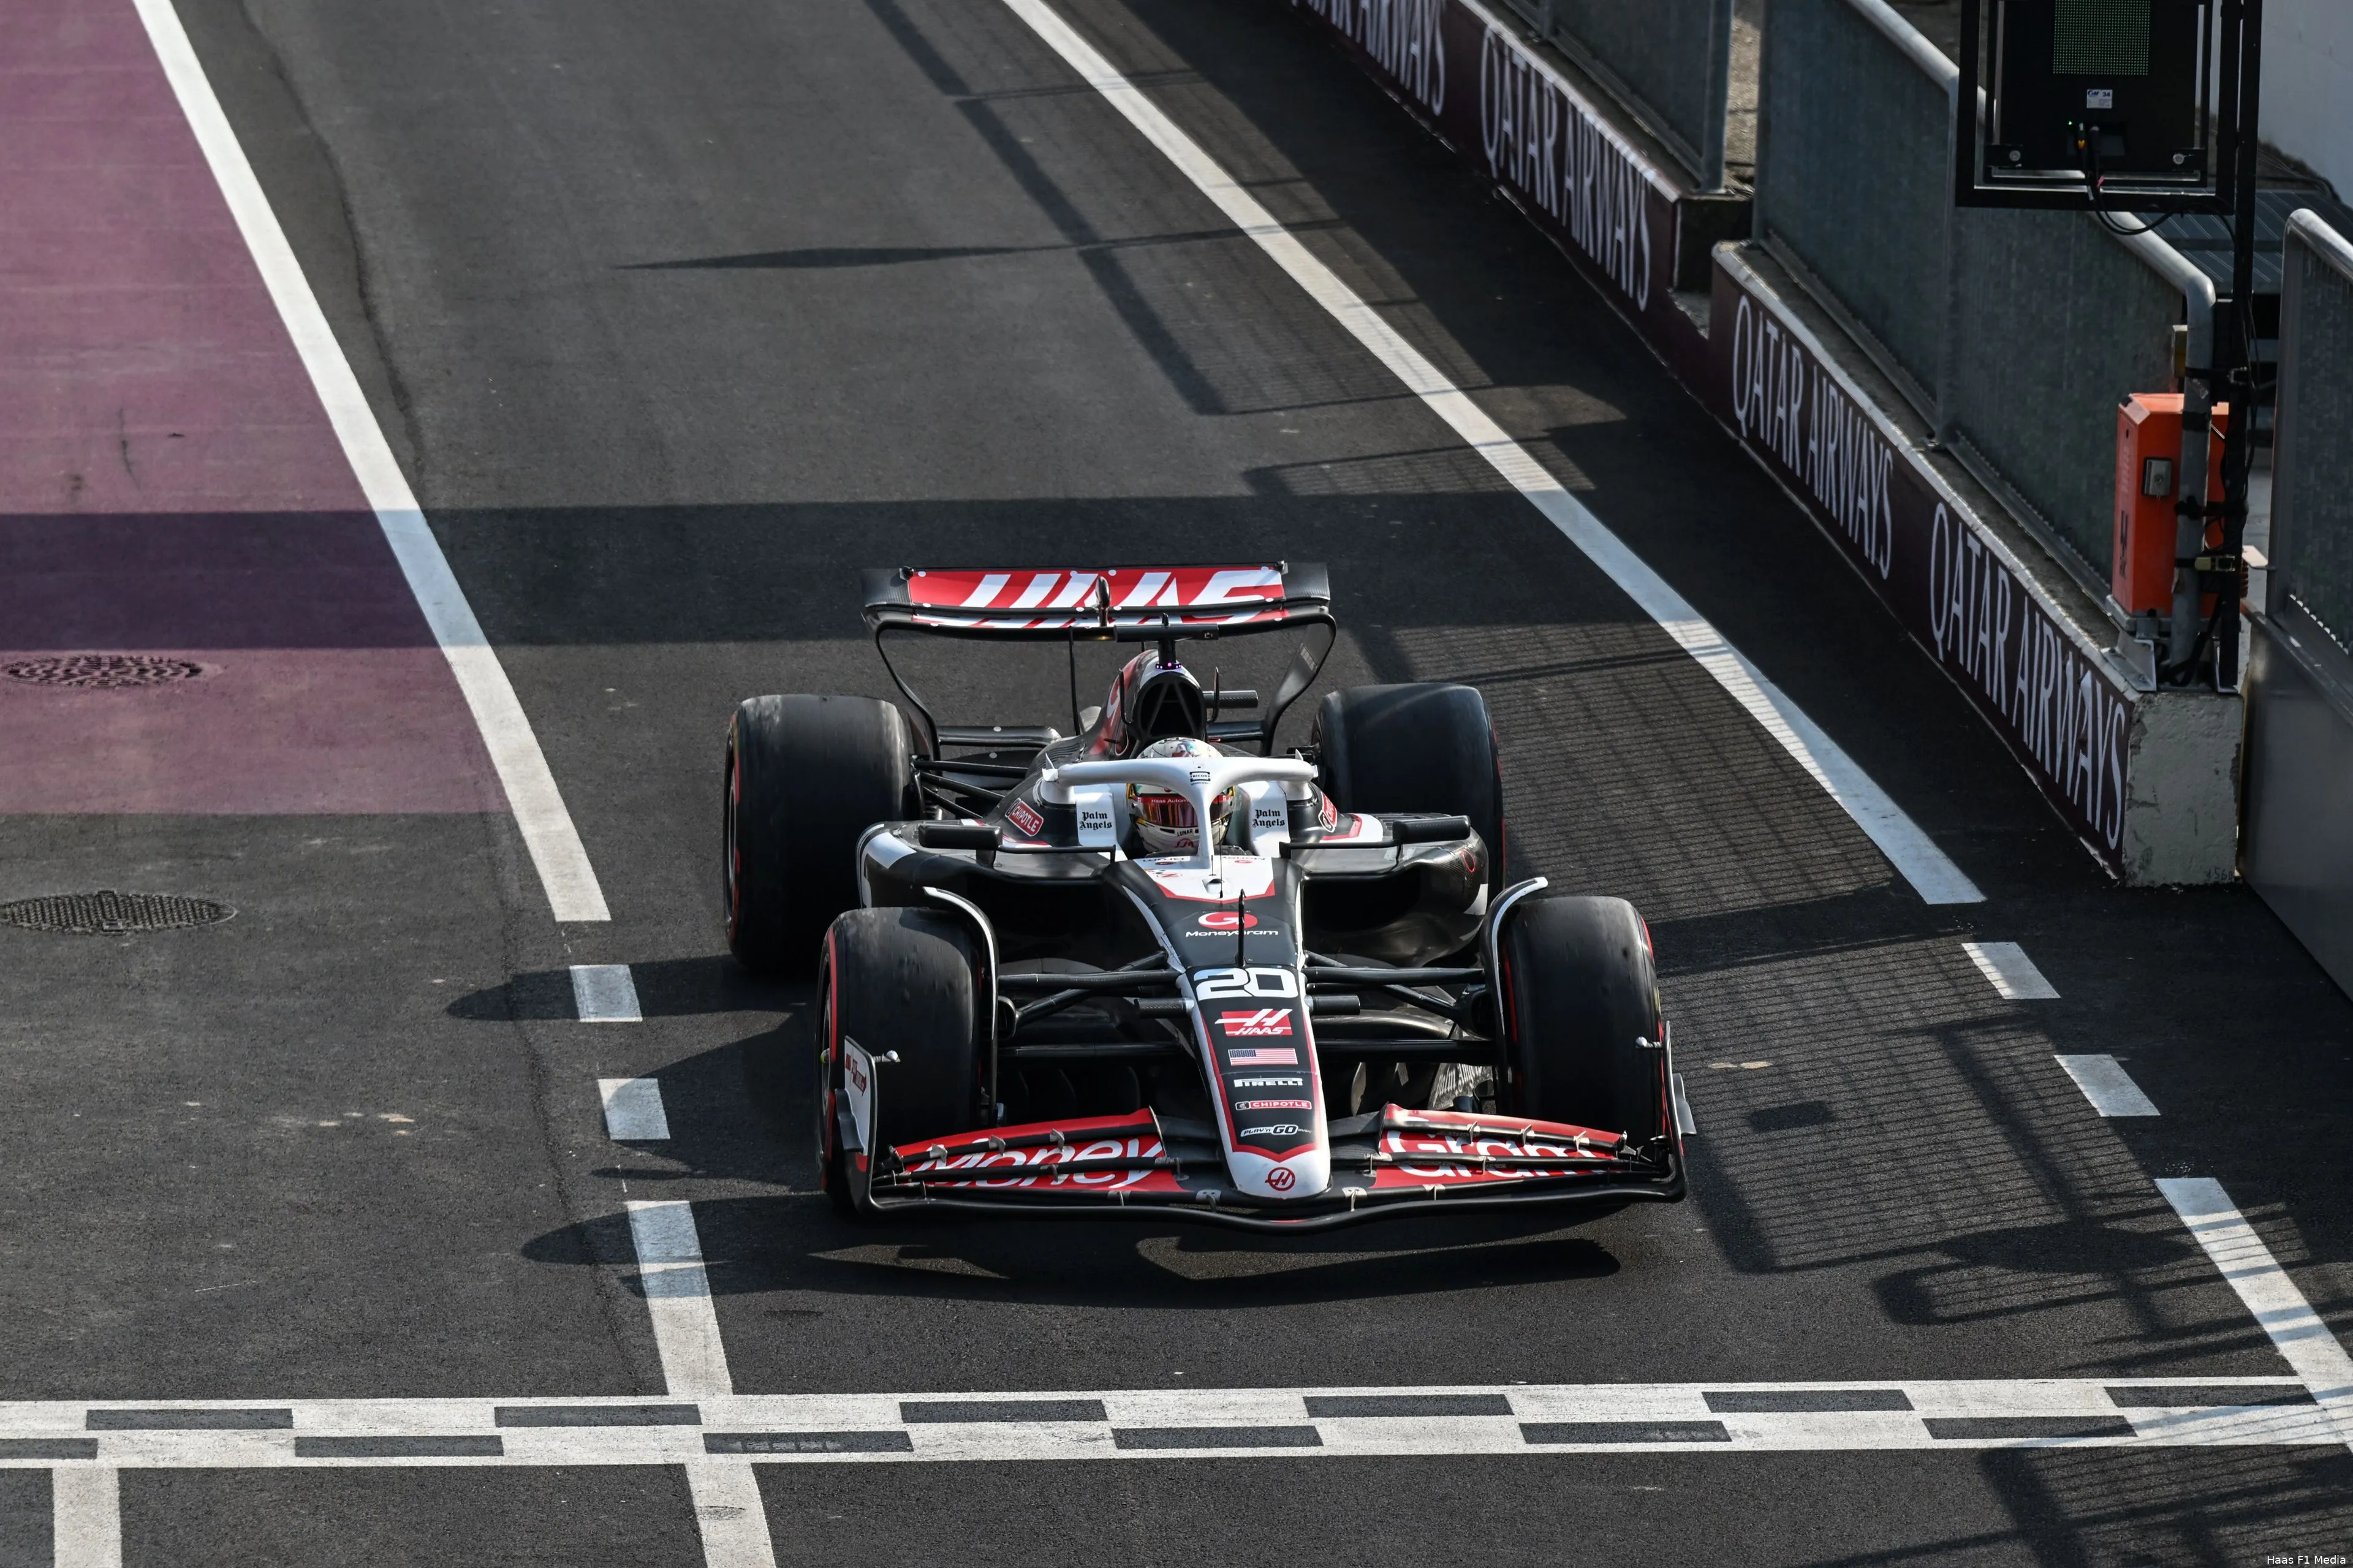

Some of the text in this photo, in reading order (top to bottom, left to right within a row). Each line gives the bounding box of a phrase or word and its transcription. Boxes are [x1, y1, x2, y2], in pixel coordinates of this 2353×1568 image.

[1480, 26, 1651, 312] QATAR AIRWAYS
[1732, 295, 1894, 580] QATAR AIRWAYS
[1930, 502, 2126, 850] QATAR AIRWAYS
[1082, 811, 1108, 822] Palm
[1255, 809, 1281, 819] Palm
[1012, 806, 1040, 833] CHIPOTLE
[1252, 819, 1286, 828] Angels
[1078, 821, 1113, 831] Angels
[1193, 967, 1299, 1002] 20
[1226, 1026, 1292, 1036] HAAS
[1233, 1078, 1303, 1088] PIRELLI
[1273, 1125, 1298, 1135] GO
